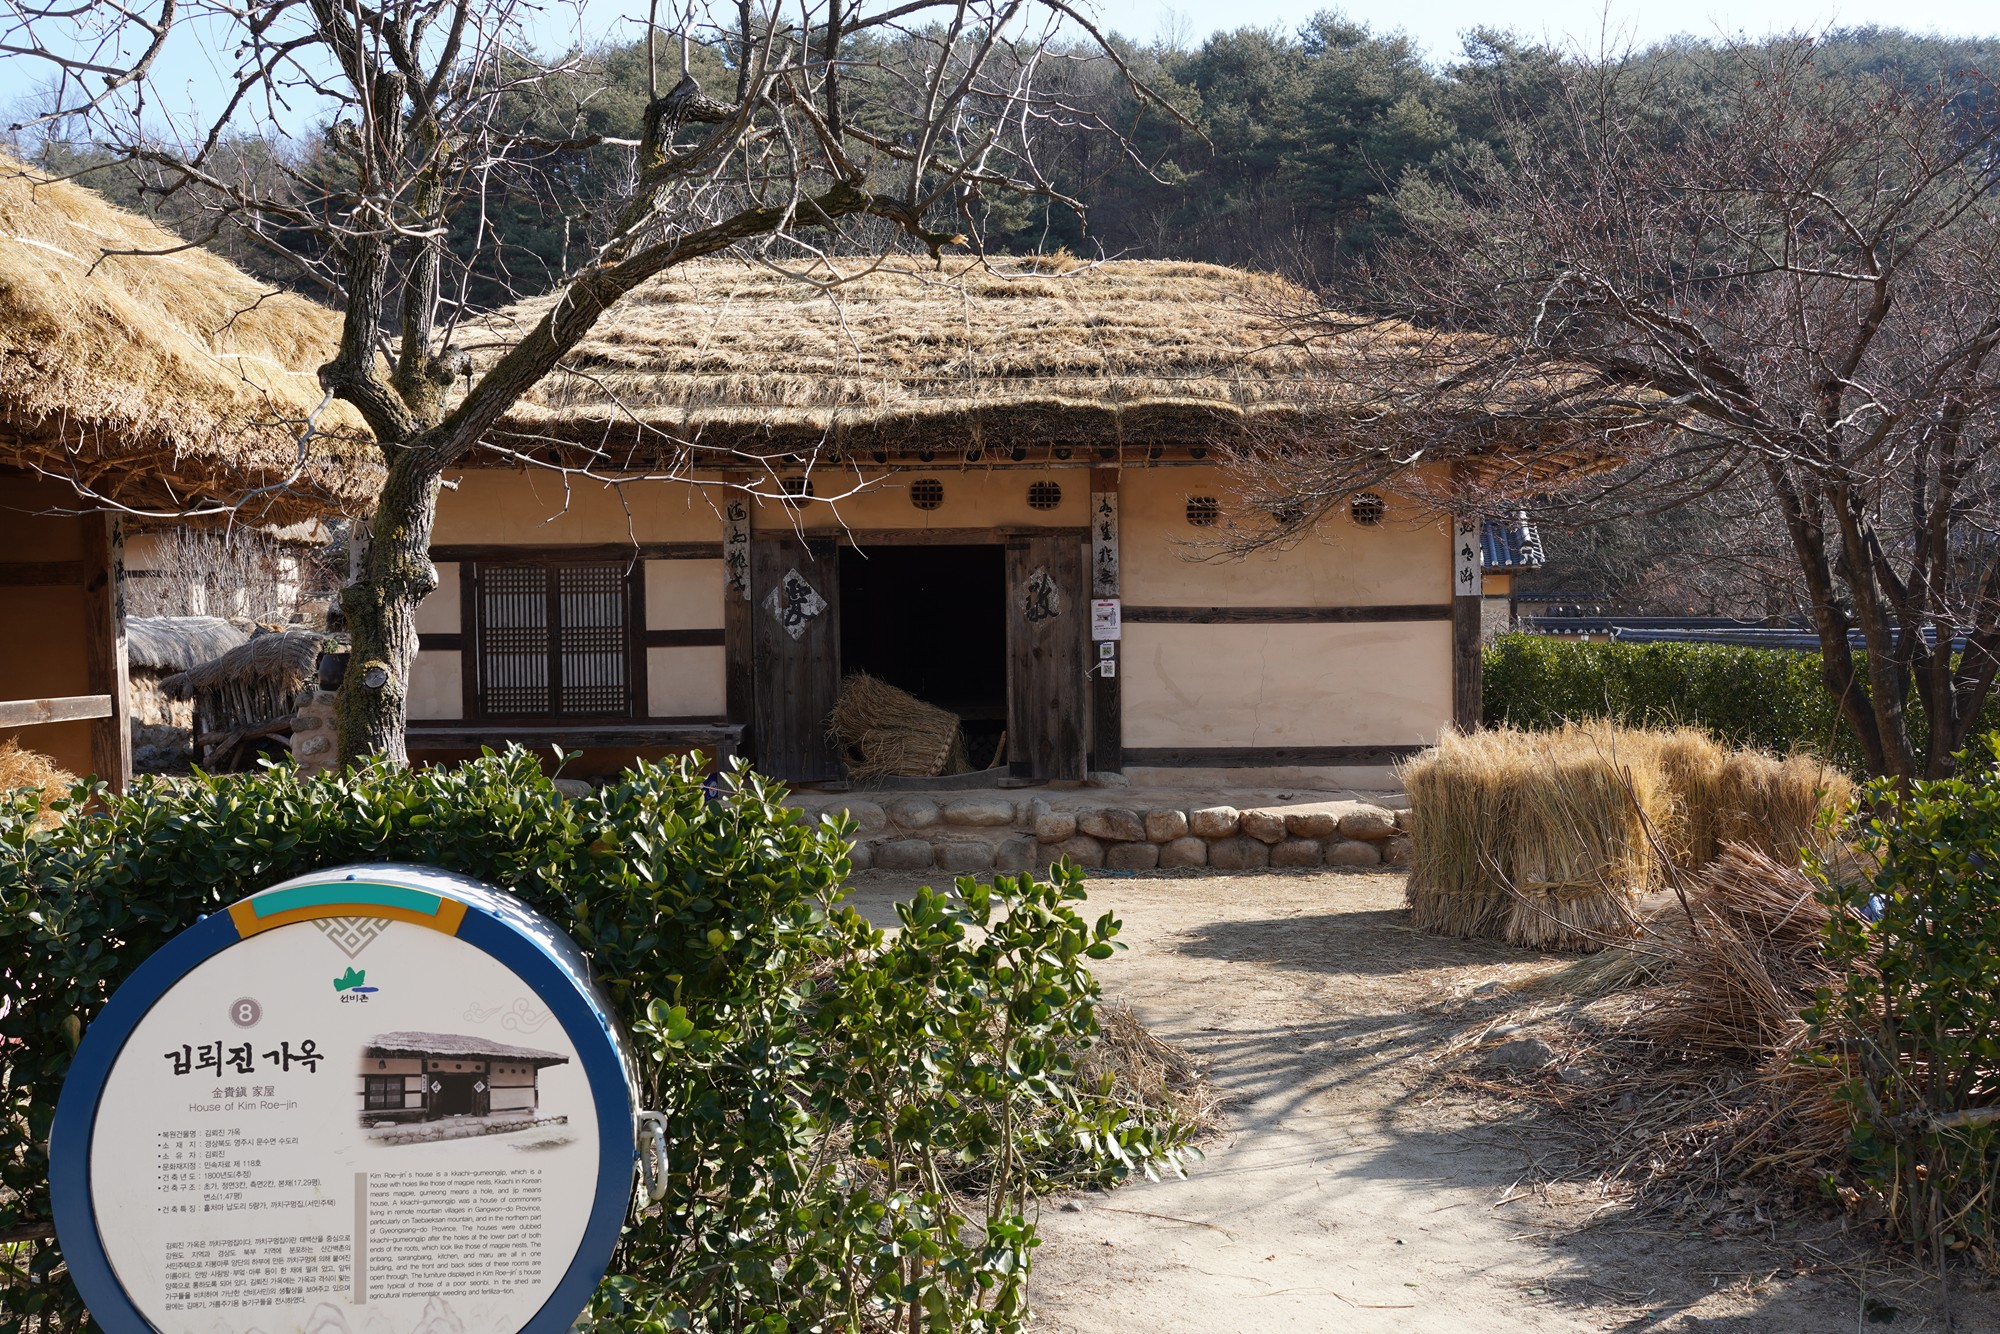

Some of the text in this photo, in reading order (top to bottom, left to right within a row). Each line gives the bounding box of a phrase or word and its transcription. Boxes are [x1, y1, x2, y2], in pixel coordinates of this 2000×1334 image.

[339, 994, 369, 1004] 선비촌
[238, 1003, 253, 1022] 8
[164, 1039, 324, 1078] 김뢰진 가옥
[252, 1085, 275, 1098] 家屋
[189, 1103, 221, 1112] House
[225, 1102, 234, 1111] of
[238, 1101, 256, 1110] Kim
[162, 1128, 241, 1139] 복원건물명 김뢰진 가옥
[205, 1140, 231, 1148] 경상북도
[234, 1139, 254, 1147] 영주시
[256, 1138, 276, 1146] 문수면
[162, 1163, 196, 1171] 문화재지정
[204, 1161, 231, 1169] 민속자료
[204, 1170, 252, 1180] 1800년도(추정)
[226, 1203, 247, 1211] 납도리
[370, 1292, 400, 1300] agricultural
